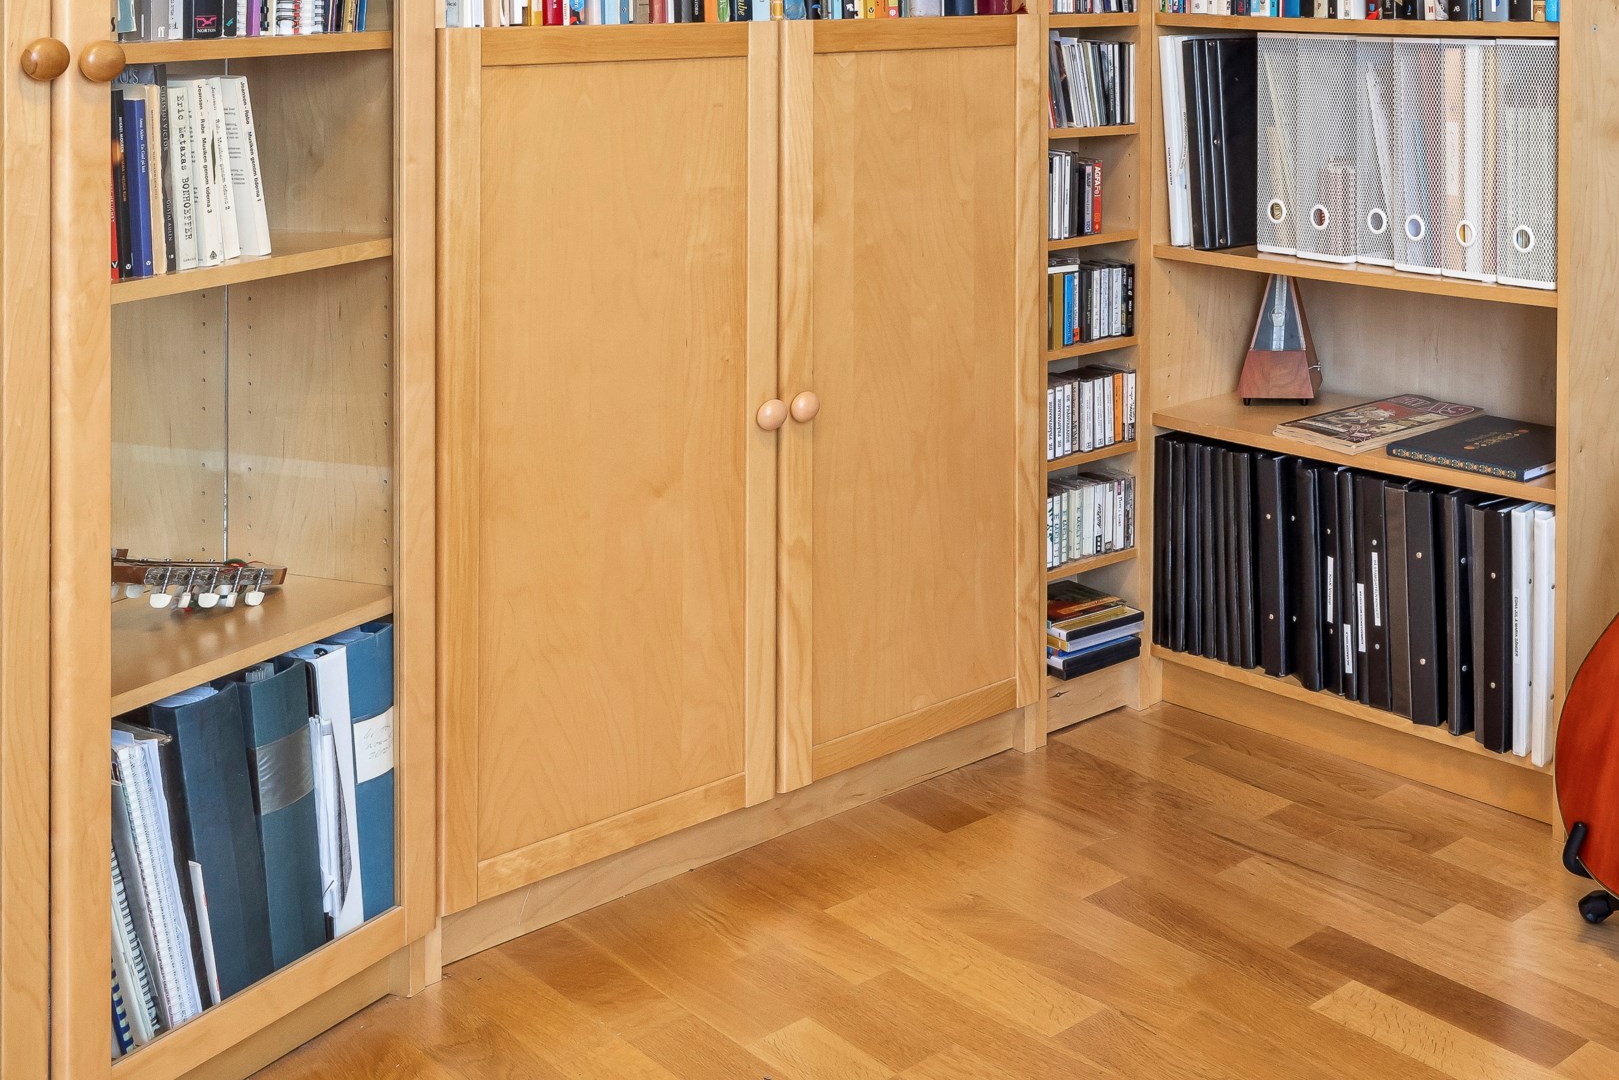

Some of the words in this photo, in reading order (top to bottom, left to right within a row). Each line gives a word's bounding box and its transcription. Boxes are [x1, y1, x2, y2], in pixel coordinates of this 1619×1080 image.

[160, 85, 168, 122] CHRISTUS
[176, 95, 185, 120] Eric
[178, 126, 187, 171] Metaxas
[182, 177, 193, 241] BONHOEFFER
